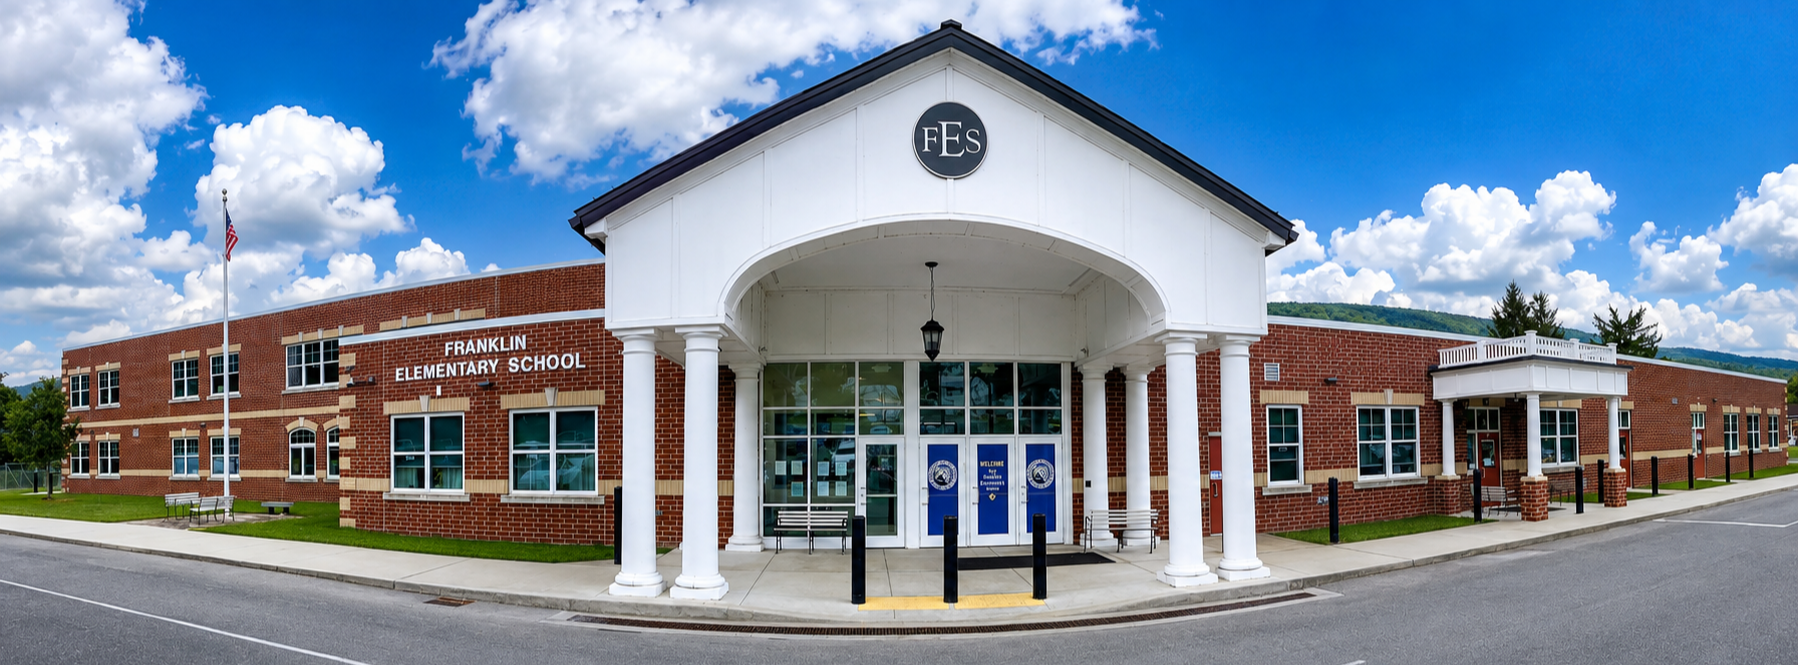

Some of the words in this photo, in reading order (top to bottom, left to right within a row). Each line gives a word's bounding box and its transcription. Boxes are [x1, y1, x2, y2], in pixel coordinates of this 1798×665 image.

[922, 121, 981, 157] FES
[445, 335, 527, 356] FRANKLIN
[395, 359, 499, 382] ELEMENTARY
[508, 352, 586, 373] SCHOOL
